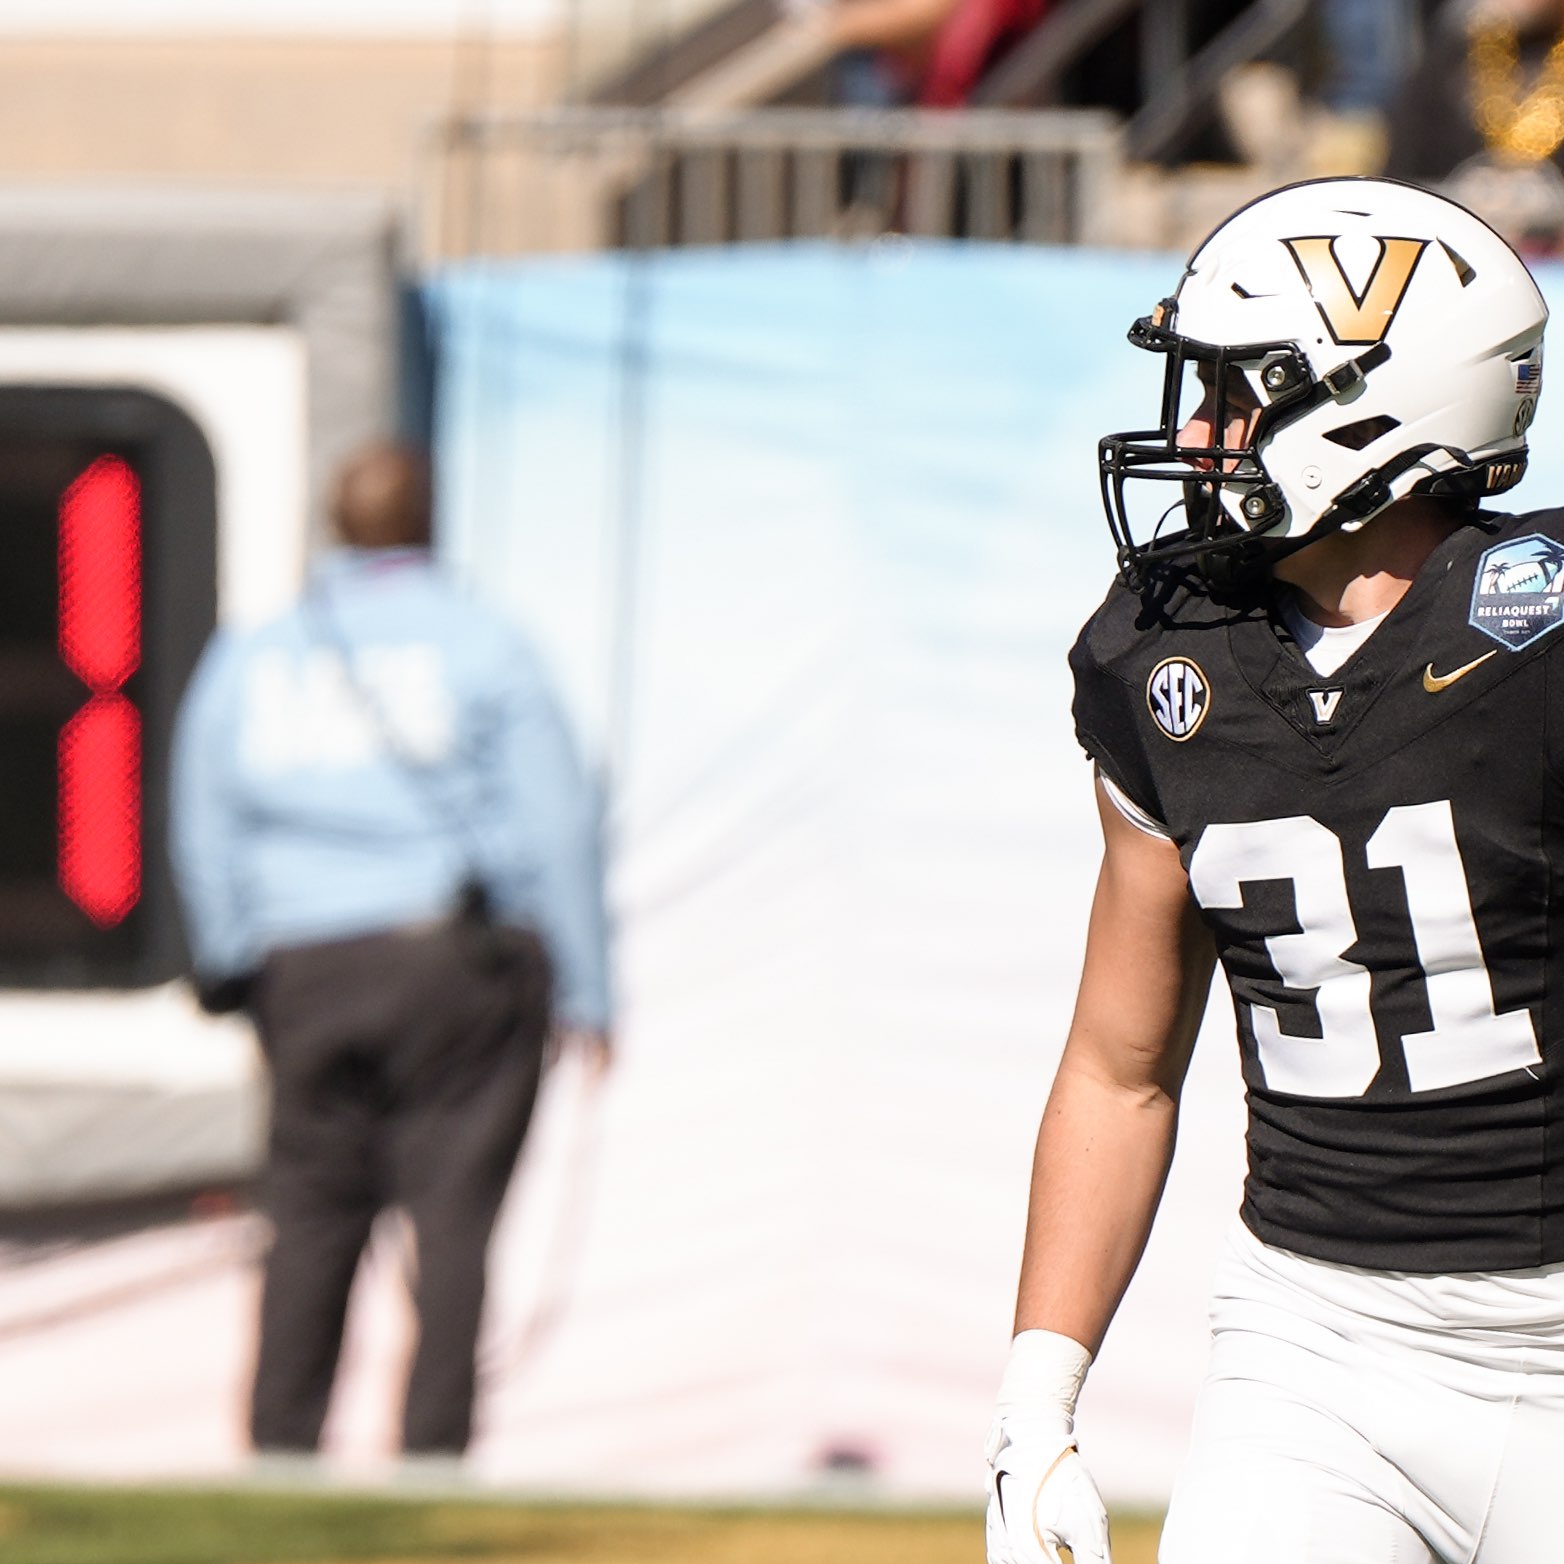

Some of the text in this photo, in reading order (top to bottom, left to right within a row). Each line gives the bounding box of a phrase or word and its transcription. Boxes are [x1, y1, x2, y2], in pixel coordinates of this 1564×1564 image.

[1277, 235, 1433, 346] V
[1477, 605, 1551, 617] RELIAQUEST
[1502, 619, 1529, 628] BOWL
[1151, 663, 1204, 735] SEC
[1307, 689, 1344, 724] V
[1189, 799, 1543, 1098] 31
